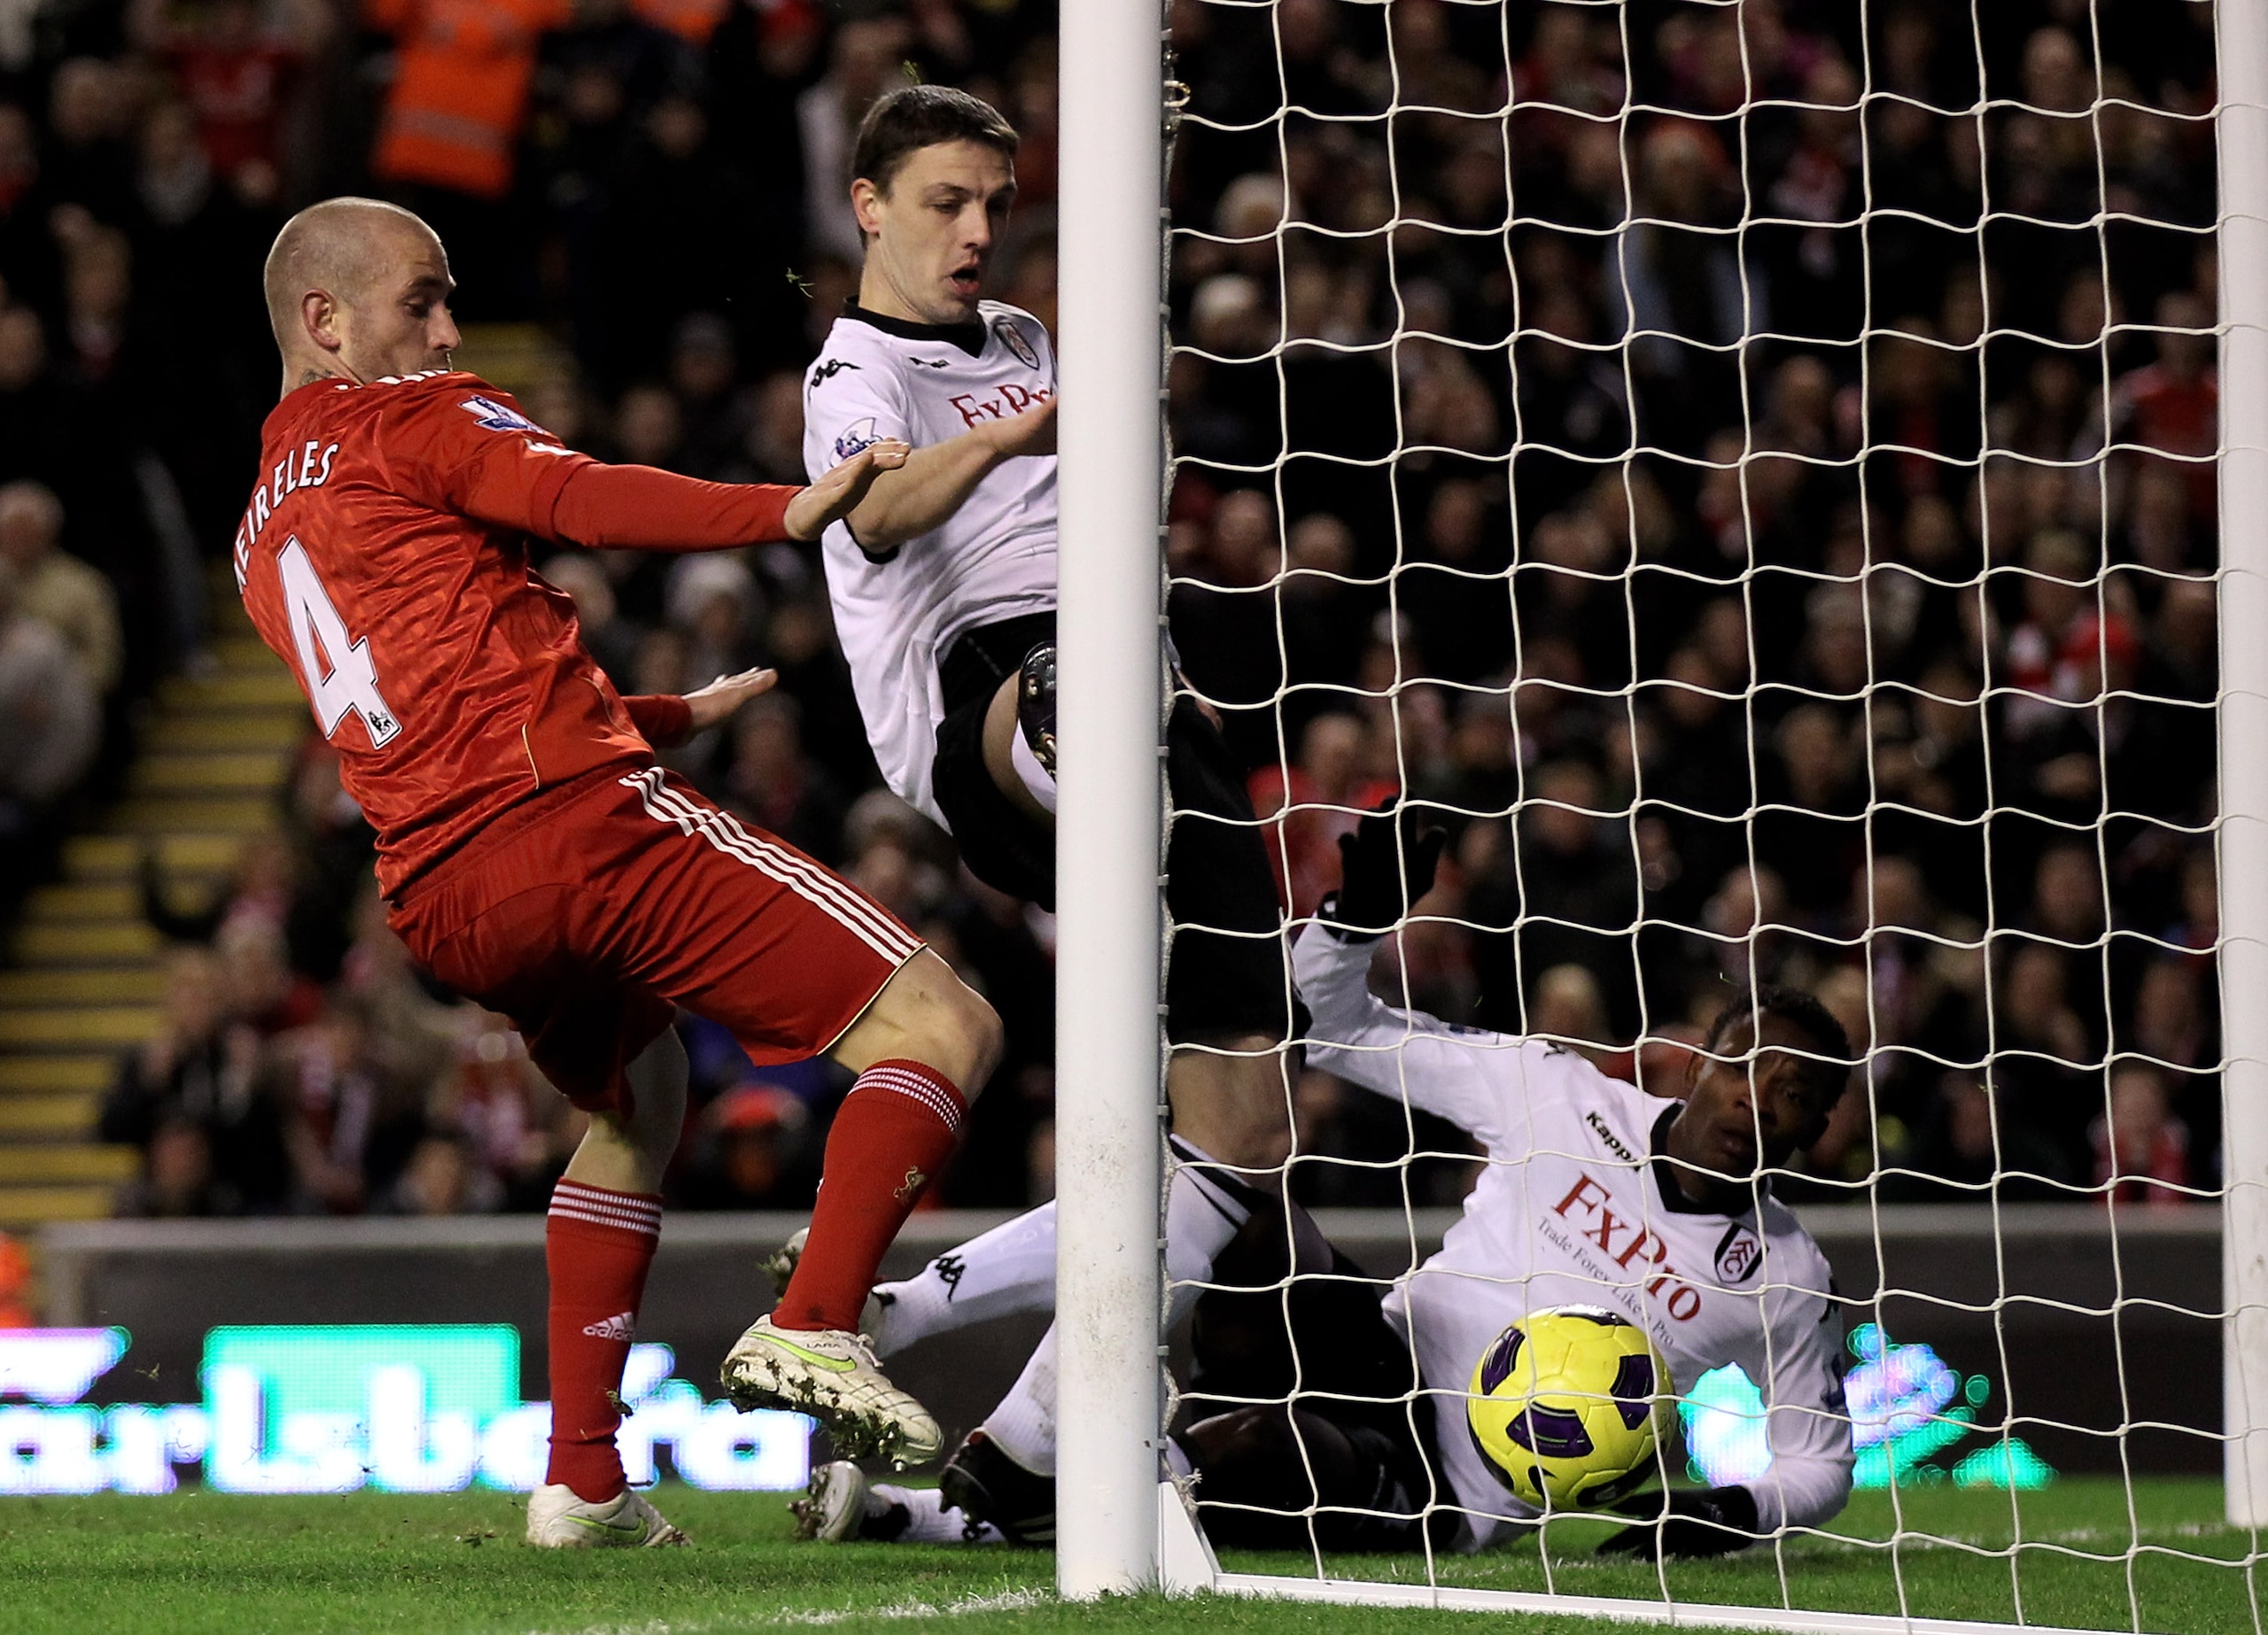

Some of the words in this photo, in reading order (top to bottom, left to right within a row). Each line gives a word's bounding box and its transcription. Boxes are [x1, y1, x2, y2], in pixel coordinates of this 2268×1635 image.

[948, 384, 1050, 429] FxPr
[276, 534, 402, 750] 4
[1538, 1216, 1573, 1251] Trade
[1652, 1317, 1674, 1347] Pro
[1552, 1170, 1701, 1321] FxPro
[1723, 1239, 1755, 1275] FFC
